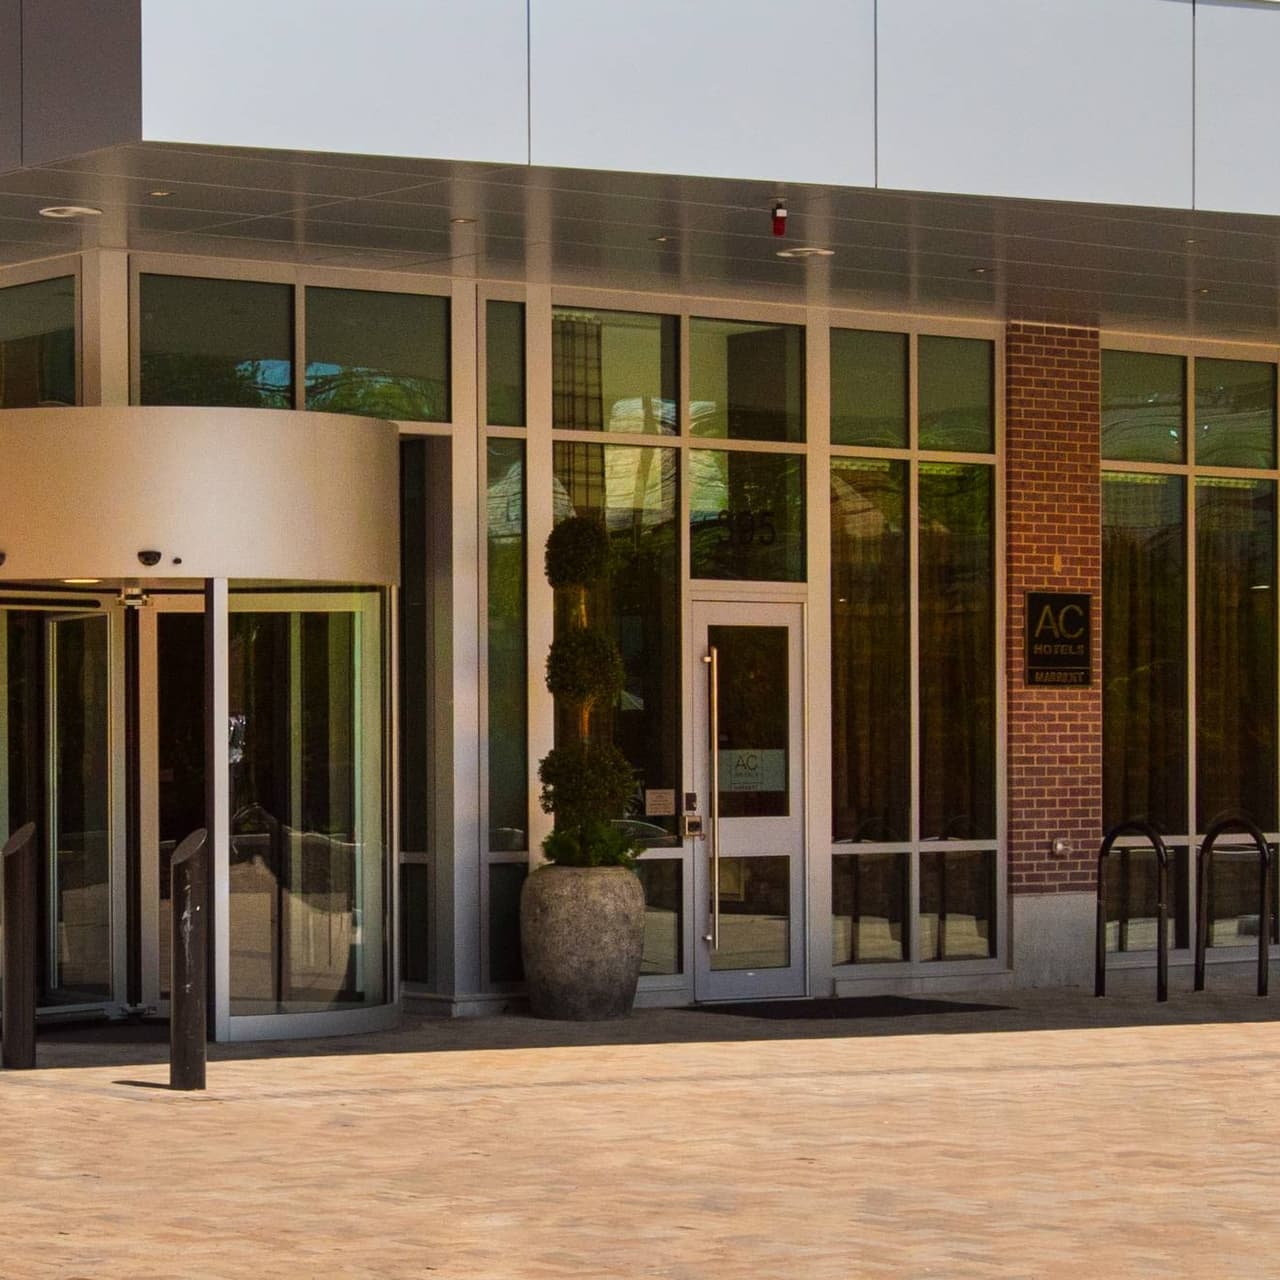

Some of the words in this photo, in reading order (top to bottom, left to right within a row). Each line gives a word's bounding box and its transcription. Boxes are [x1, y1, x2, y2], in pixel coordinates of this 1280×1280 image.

[1034, 604, 1084, 638] AC
[1033, 643, 1085, 655] HOTELS
[735, 754, 758, 771] AC
